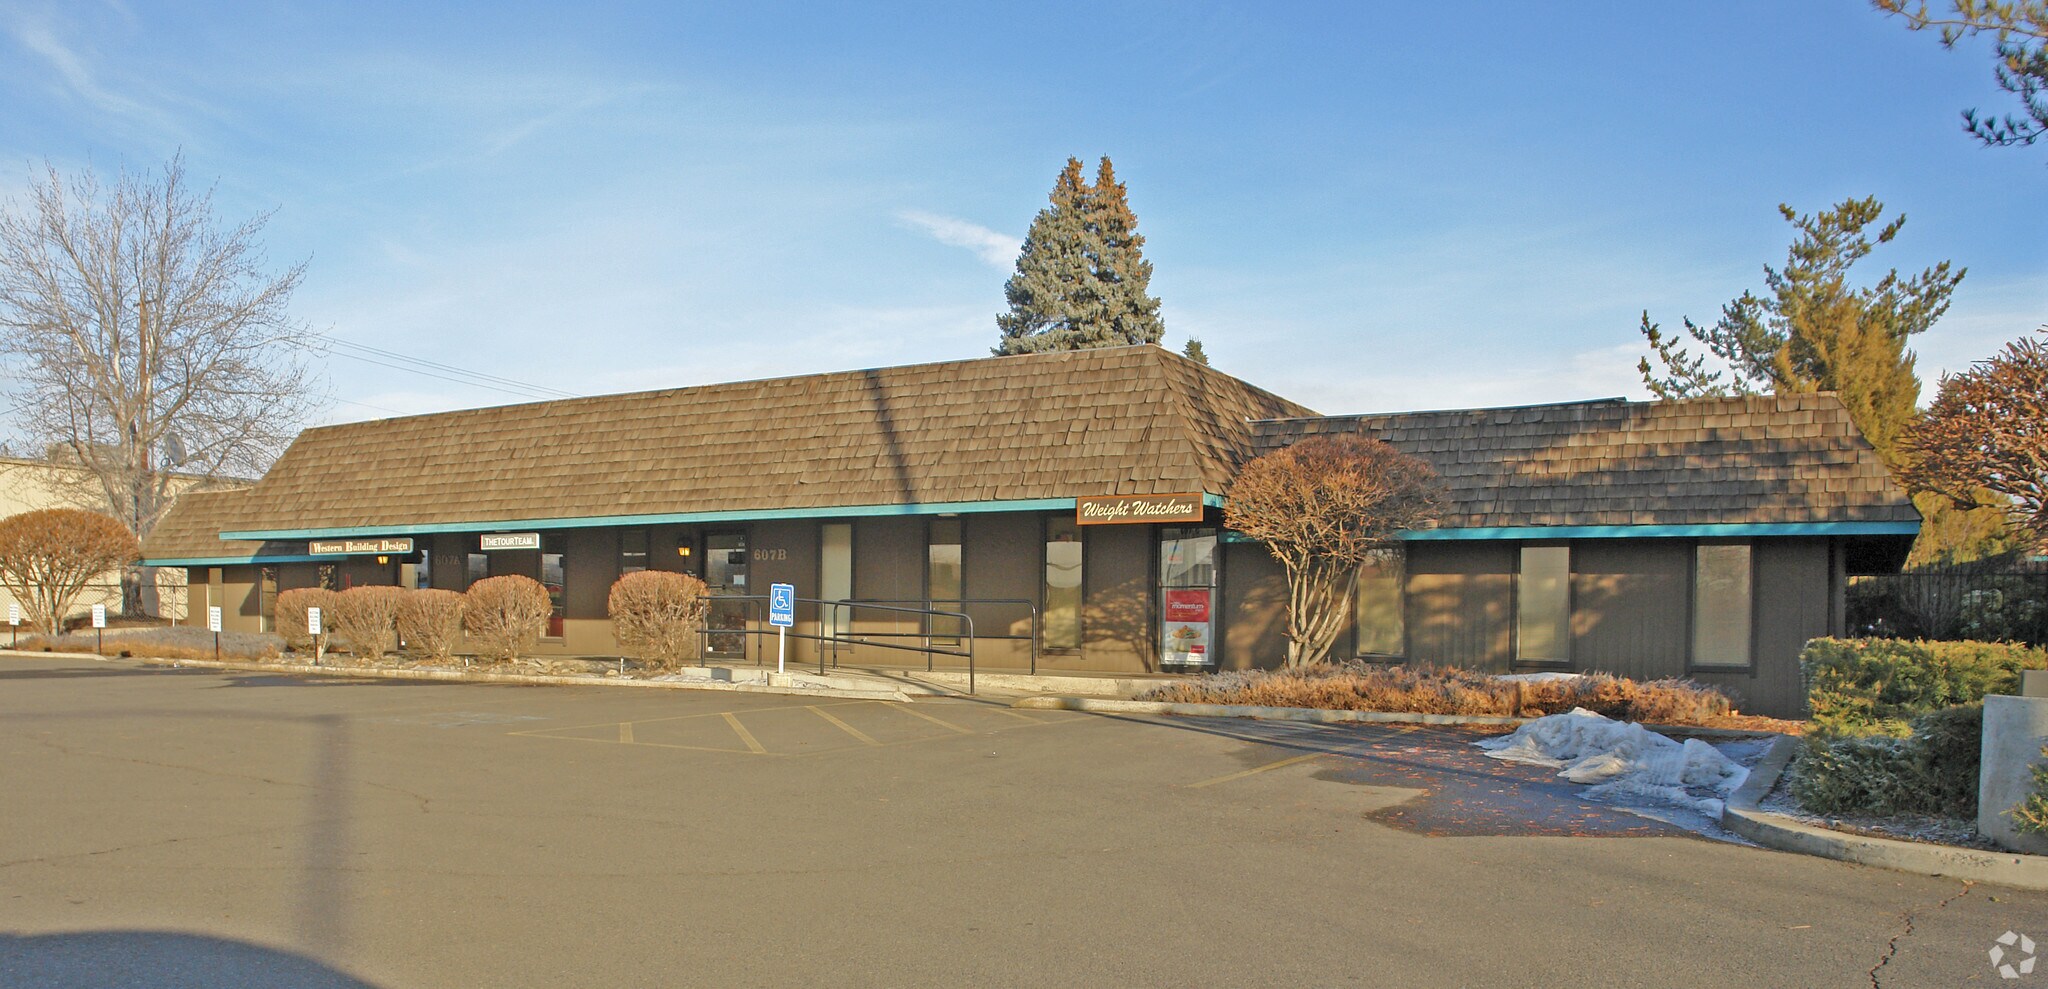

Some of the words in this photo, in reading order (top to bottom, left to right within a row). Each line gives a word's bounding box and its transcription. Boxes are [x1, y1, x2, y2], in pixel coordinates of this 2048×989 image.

[1082, 500, 1129, 521] Weight
[1132, 499, 1193, 516] Watchers
[313, 543, 342, 553] Western
[345, 541, 378, 552] Building
[381, 540, 408, 552] Design
[435, 553, 460, 566] 607A
[754, 549, 787, 560] 607B
[771, 612, 792, 622] PARKING
